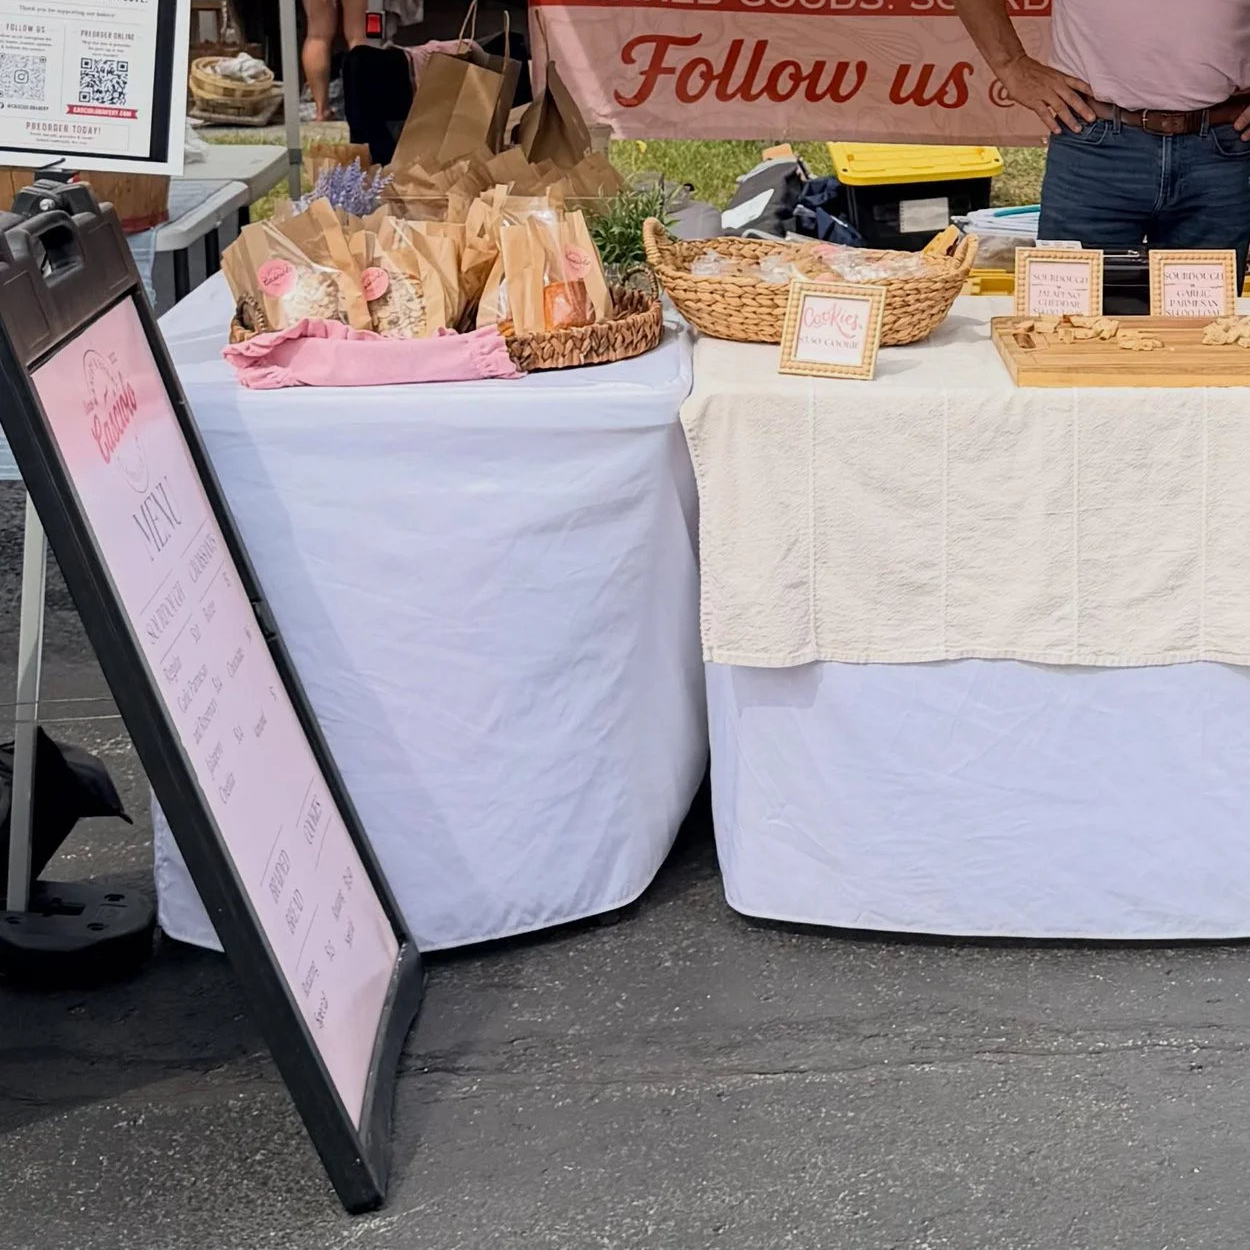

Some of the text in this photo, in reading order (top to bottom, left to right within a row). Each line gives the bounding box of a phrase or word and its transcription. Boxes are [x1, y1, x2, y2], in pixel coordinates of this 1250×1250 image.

[614, 31, 868, 108] Follow
[888, 62, 975, 109] us
[26, 121, 102, 134] PREORDER TODAY!
[1163, 272, 1223, 280] SOURDOUGH
[1170, 299, 1218, 307] PARMESAN
[91, 379, 138, 464] Casciolo
[132, 476, 182, 561] MENU
